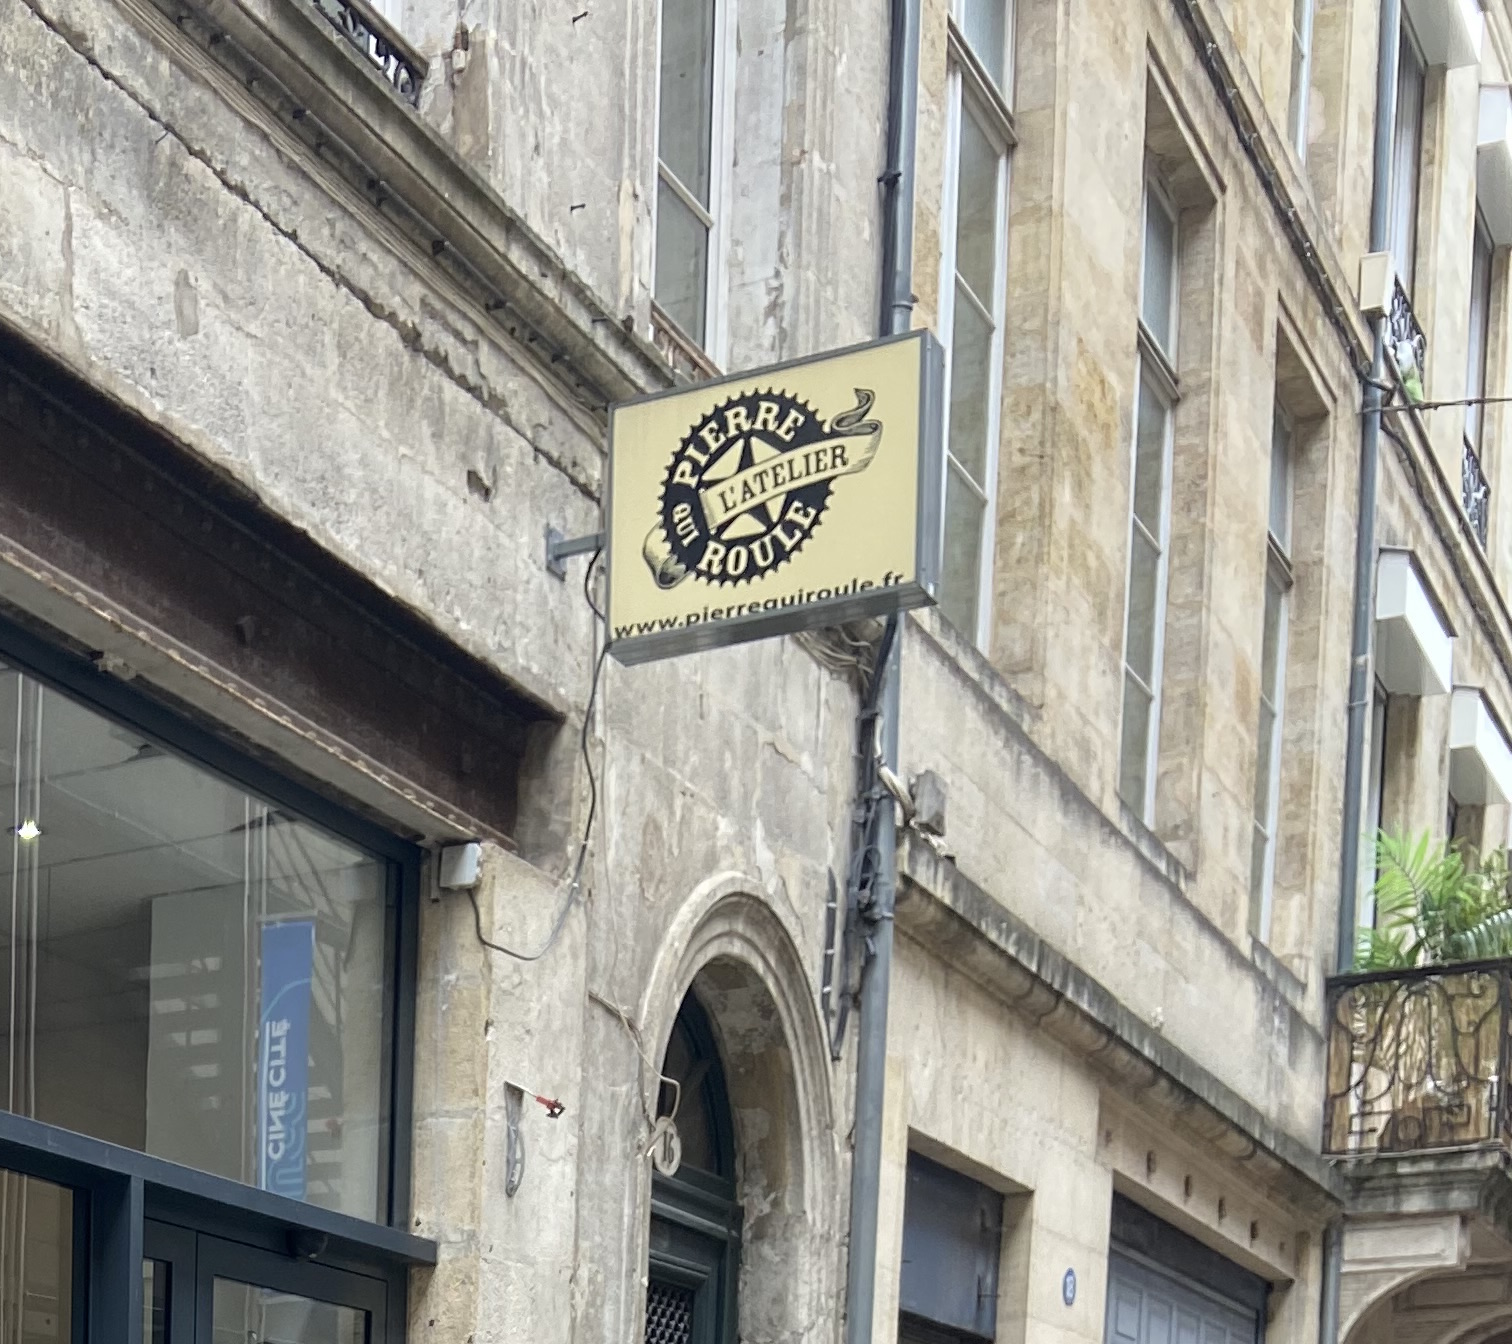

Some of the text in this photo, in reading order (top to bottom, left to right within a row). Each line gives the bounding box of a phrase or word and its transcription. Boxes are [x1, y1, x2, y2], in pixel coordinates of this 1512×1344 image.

[673, 400, 806, 489] PIERRE
[719, 444, 849, 513] L'ATELIER
[672, 501, 699, 546] QUI
[697, 500, 817, 576] ROULE
[614, 572, 904, 639] www.pierrequiroule.fr
